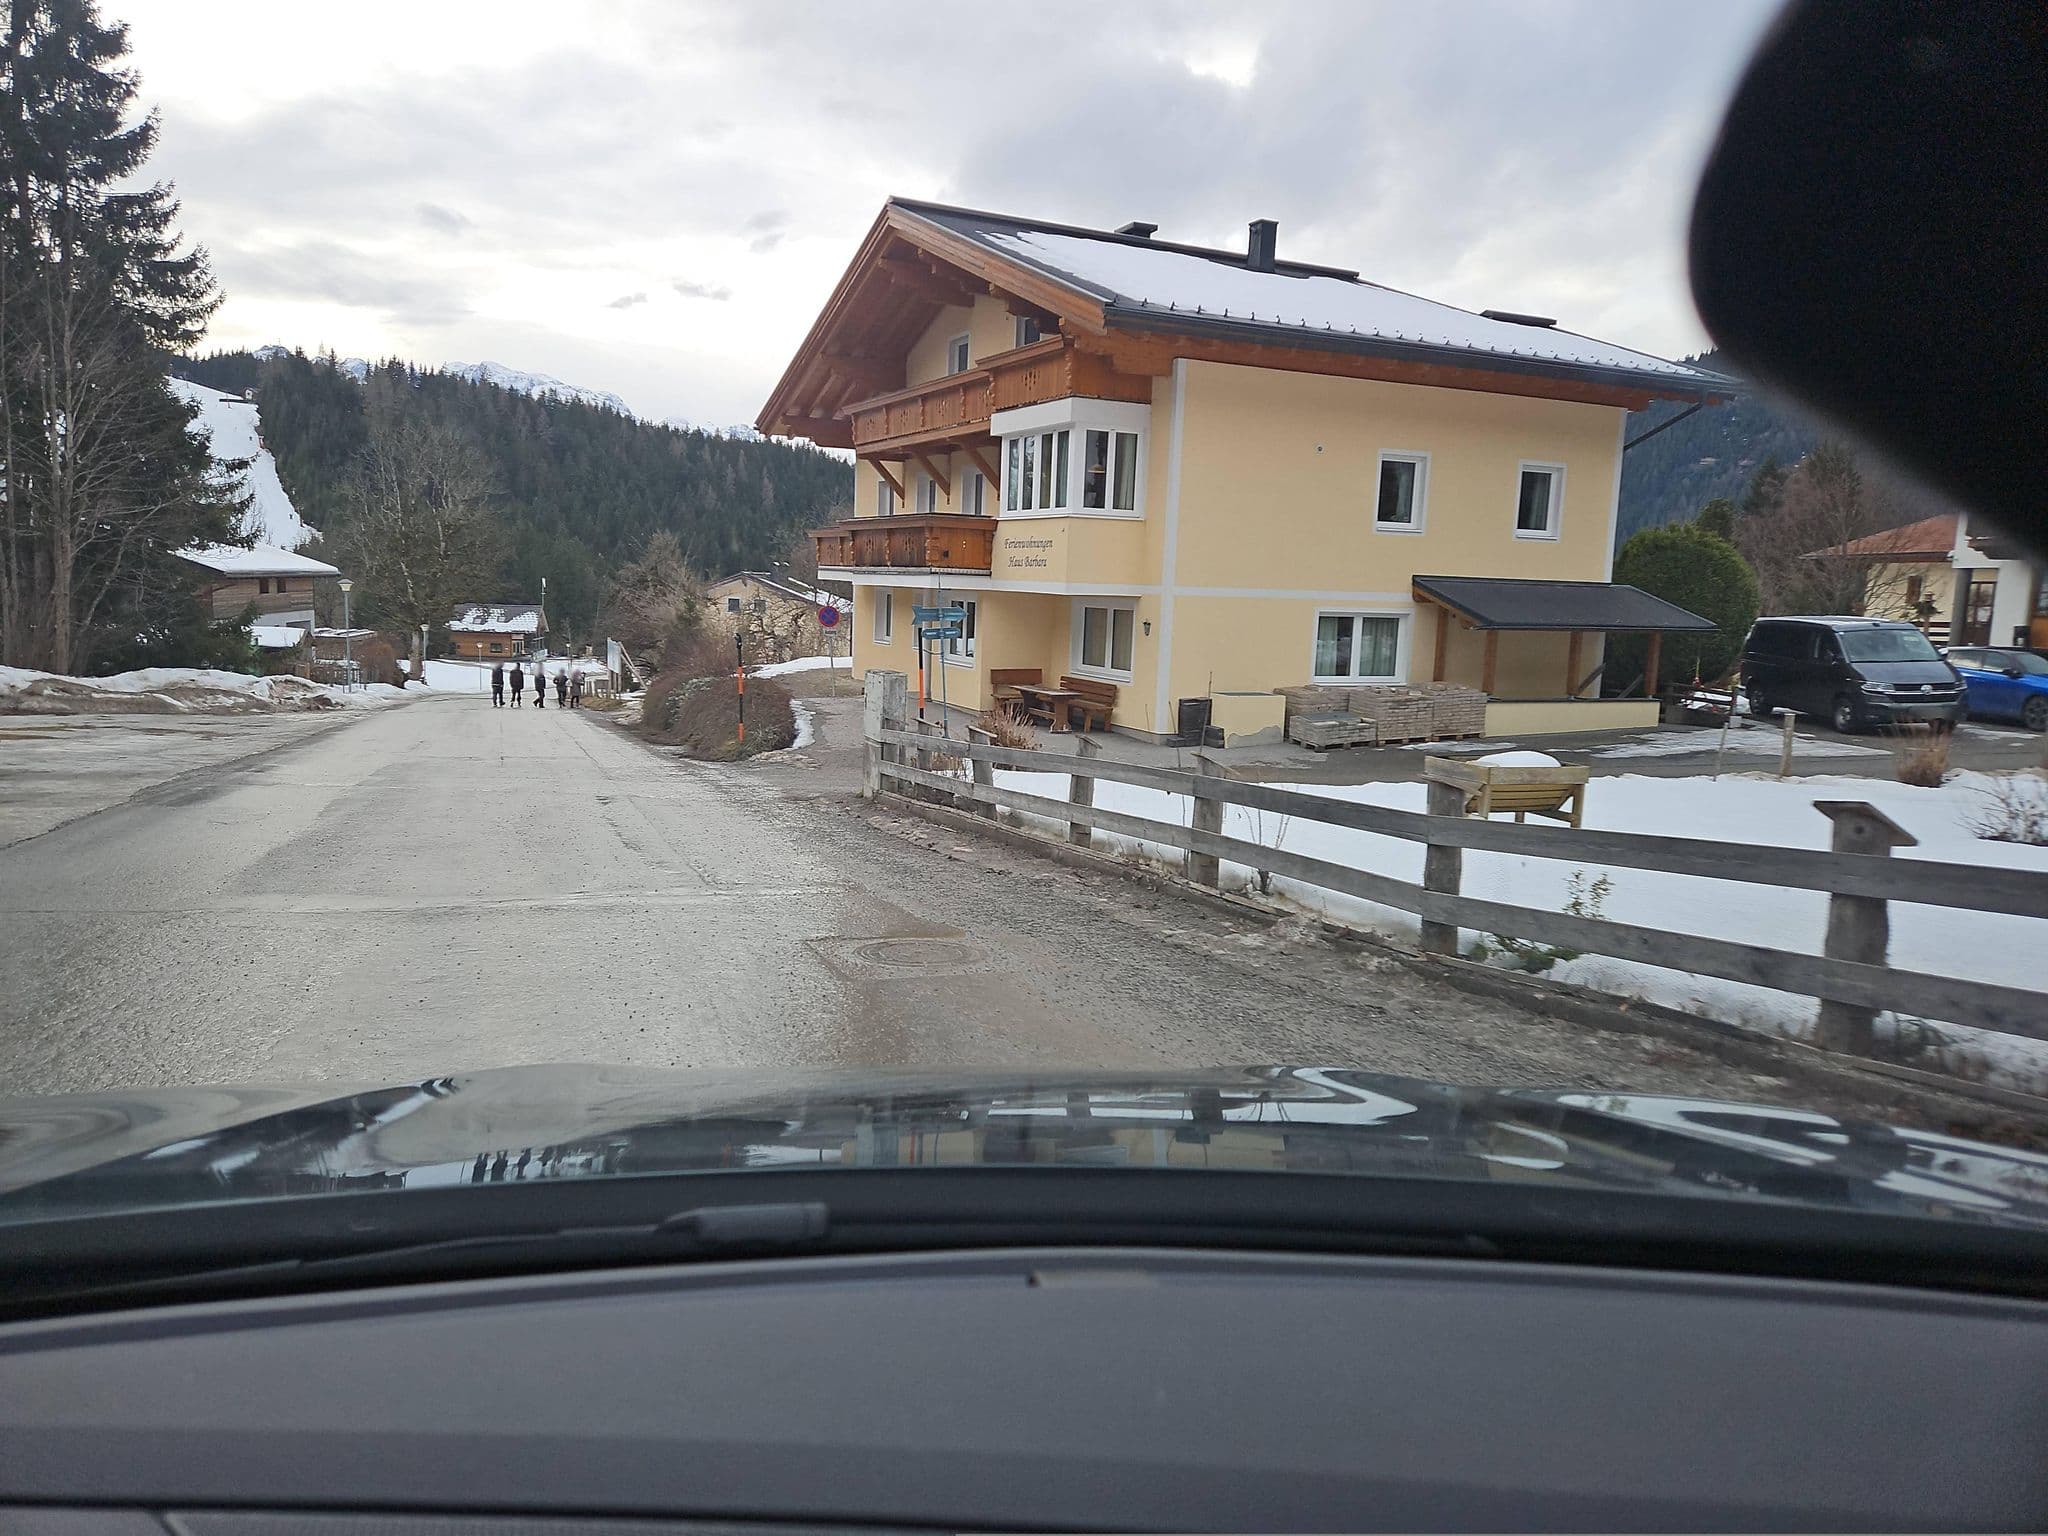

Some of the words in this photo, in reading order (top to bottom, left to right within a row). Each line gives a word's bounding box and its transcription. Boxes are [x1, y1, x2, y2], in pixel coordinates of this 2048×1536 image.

[1005, 536, 1053, 552] Ferienwohnungen
[1008, 556, 1024, 567] Haus
[1025, 555, 1047, 567] Barbara
